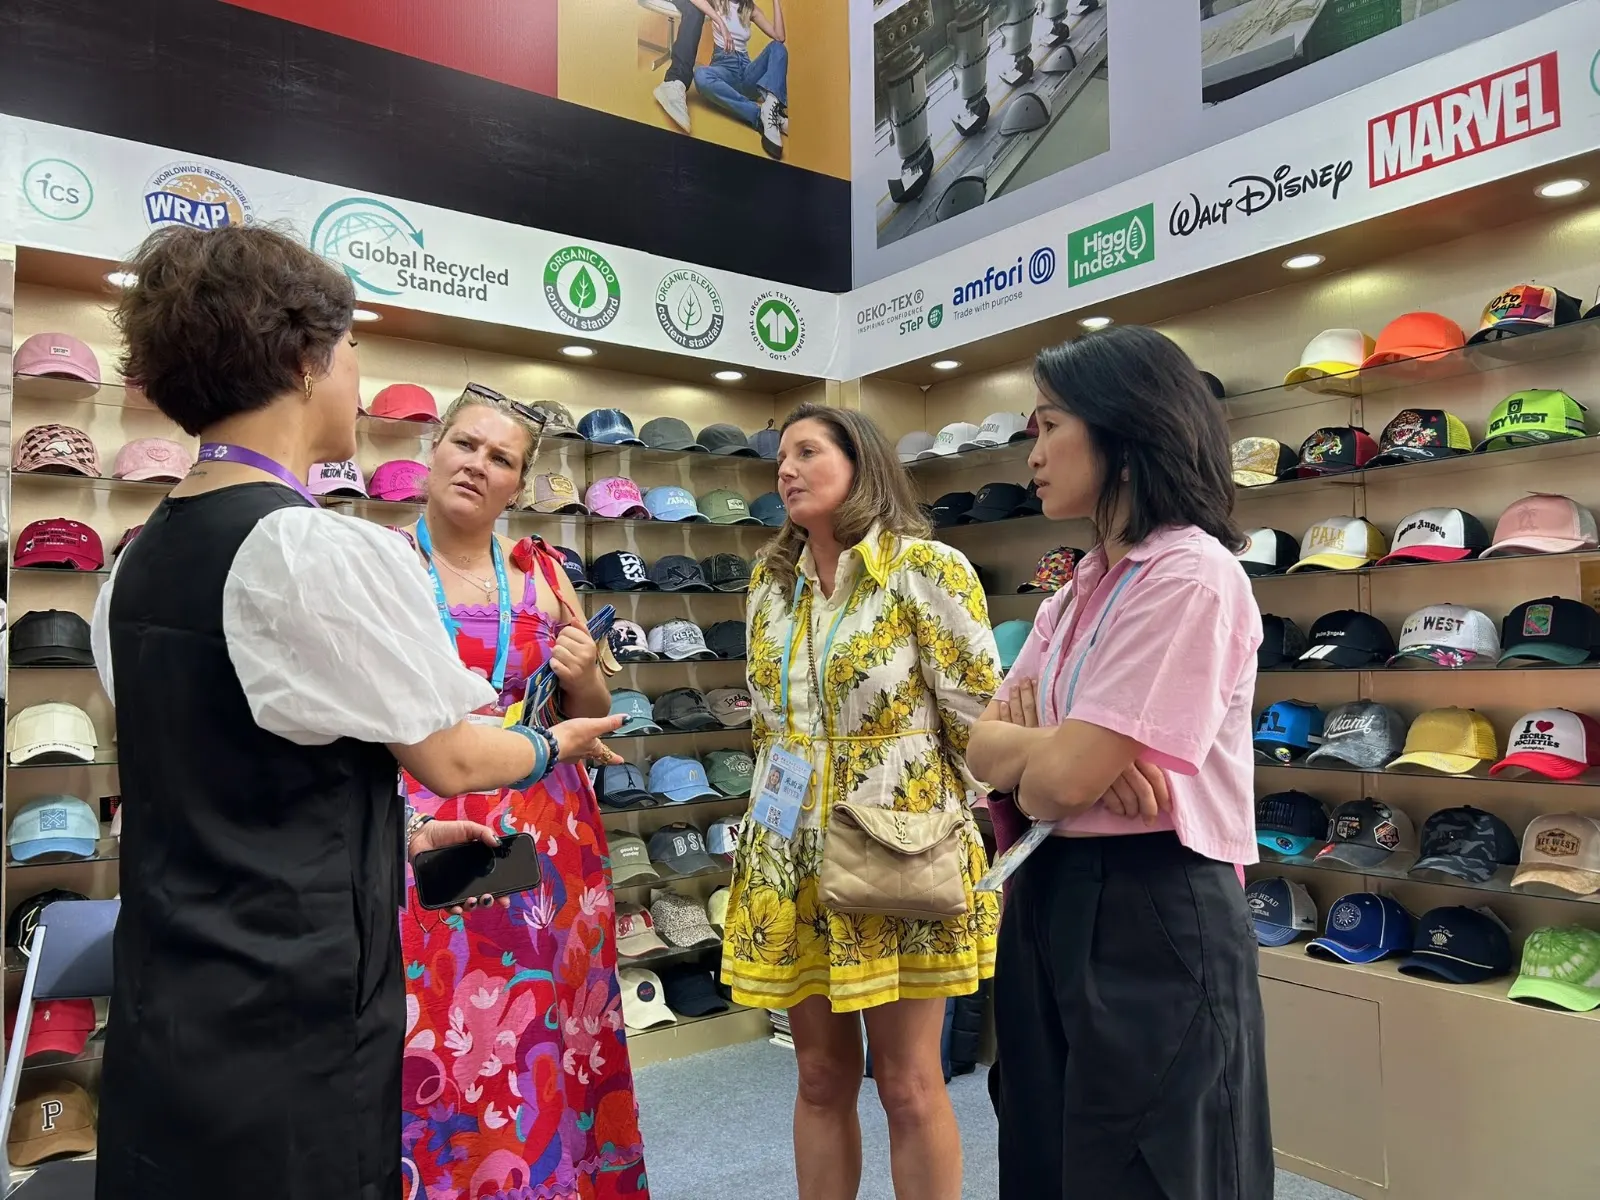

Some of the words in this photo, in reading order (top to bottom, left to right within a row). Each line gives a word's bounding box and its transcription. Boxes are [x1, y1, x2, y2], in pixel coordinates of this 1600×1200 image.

[1372, 62, 1555, 181] MARVEL
[153, 165, 202, 186] WORLDWIDE
[204, 168, 252, 211] RESPONSIBLE
[149, 193, 226, 229] WRAP
[1083, 227, 1126, 256] Higg
[348, 240, 417, 269] Global
[423, 253, 509, 287] Recycled
[549, 248, 598, 272] ORGANIC
[597, 260, 615, 283] 100
[1073, 248, 1126, 280] Index
[397, 269, 488, 301] Standard
[658, 271, 690, 303] ORGANIC
[690, 273, 722, 314] BLENDED
[952, 255, 1023, 307] amfori
[546, 285, 579, 328] content
[580, 296, 619, 330] standard
[749, 290, 773, 317] ORGANIC
[775, 291, 801, 315] TEXTILE
[953, 307, 974, 321] Trade
[974, 301, 990, 313] with
[991, 290, 1023, 309] purpose
[657, 305, 688, 346] content
[688, 316, 722, 348] standard
[857, 319, 885, 335] INSPIRING
[886, 306, 923, 325] CONFIDENCE
[899, 315, 924, 336] STeP
[748, 320, 765, 352] GLOBAL
[790, 316, 807, 357] STANDARD
[769, 352, 787, 361] GOTS
[1489, 416, 1508, 435] KEY
[1508, 412, 1549, 425] WEST
[1417, 519, 1446, 539] Angels
[1423, 615, 1465, 635] WEST
[1323, 713, 1375, 738] Miami
[1519, 733, 1554, 741] SECRET
[1522, 720, 1535, 733] I
[1513, 739, 1560, 749] SOCIETIES
[1552, 838, 1576, 851] WEST
[1258, 892, 1280, 908] HEAD
[41, 1100, 62, 1131] P
